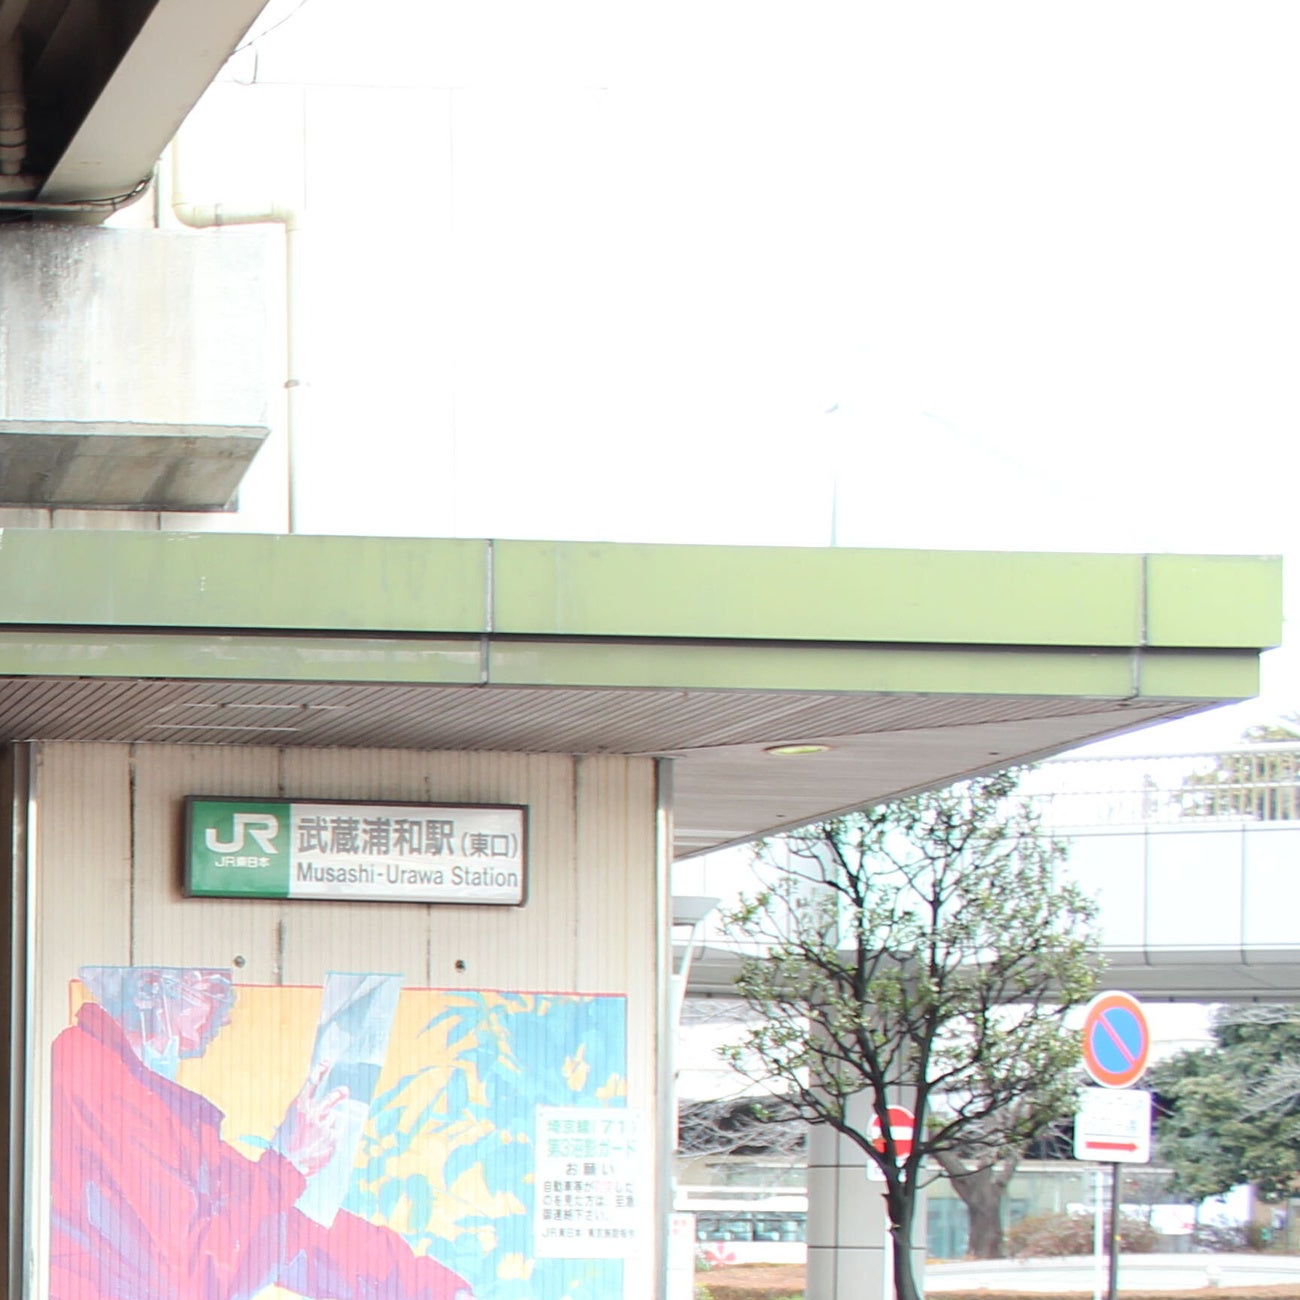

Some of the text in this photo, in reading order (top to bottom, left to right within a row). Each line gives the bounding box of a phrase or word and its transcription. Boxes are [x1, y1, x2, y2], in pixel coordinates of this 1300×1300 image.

[205, 813, 279, 854] JR
[214, 855, 271, 868] JR東日本
[296, 862, 518, 888] Musashi-Urawa Station
[565, 1162, 615, 1176] お願い
